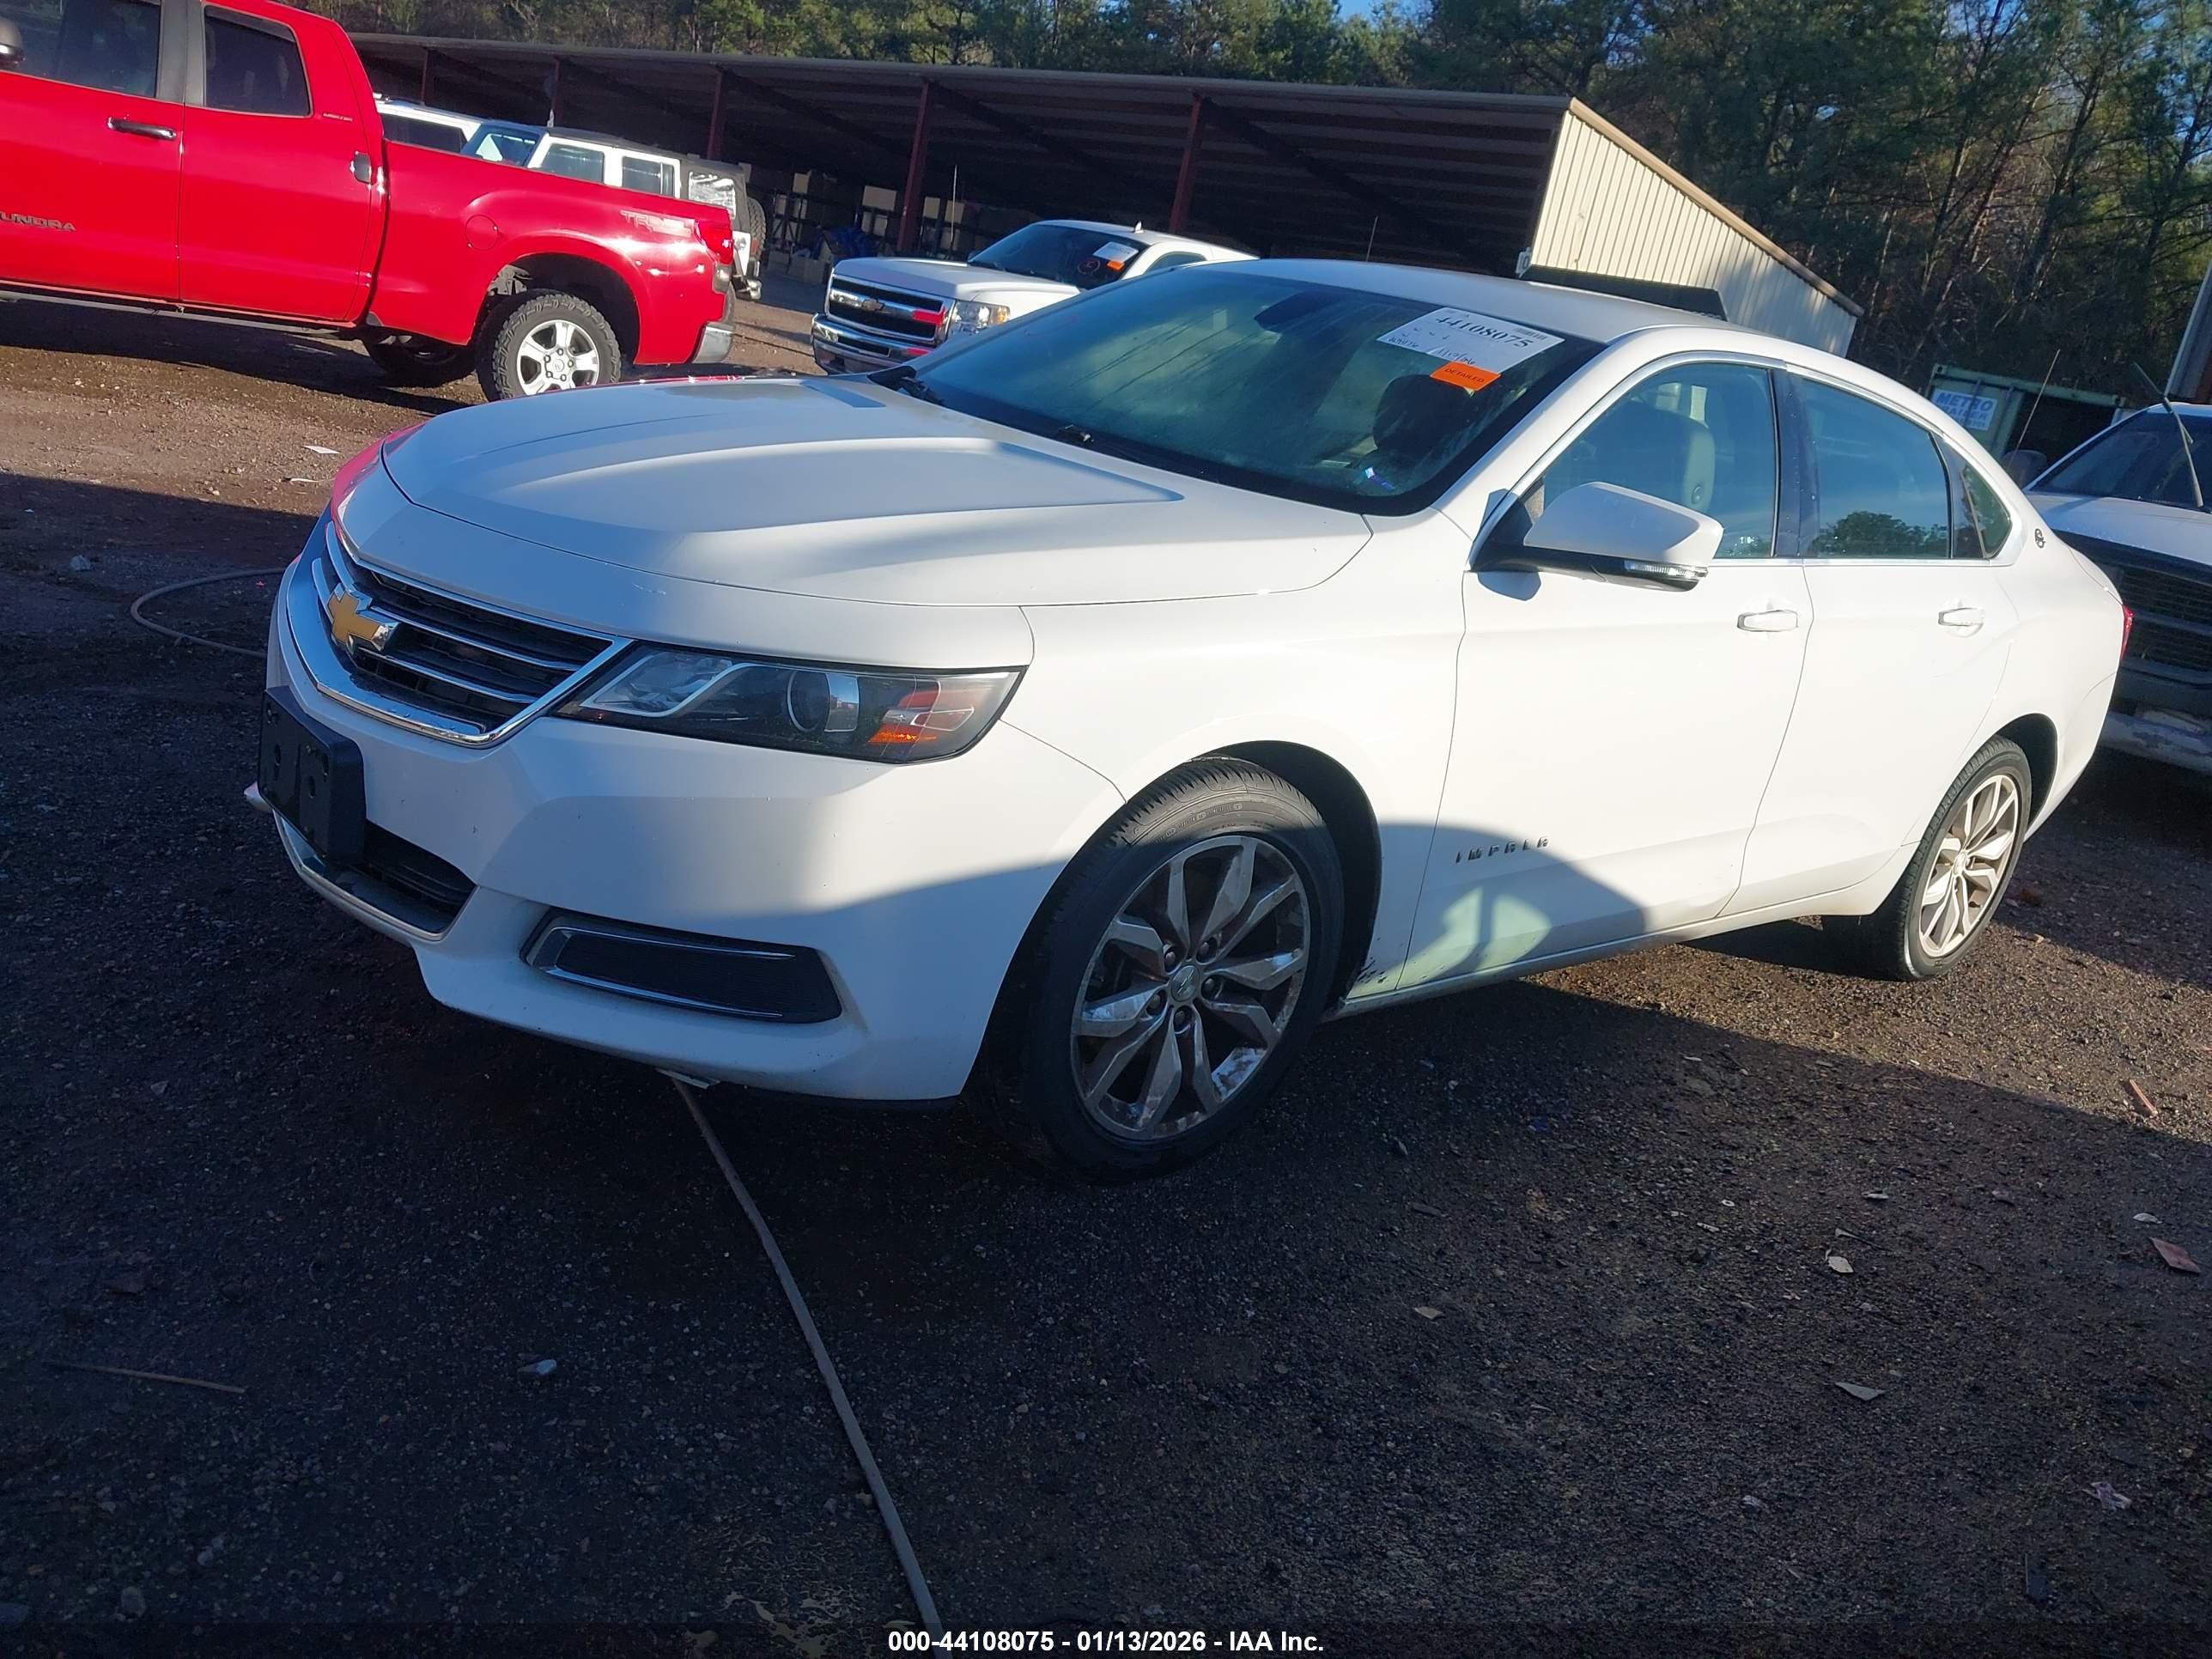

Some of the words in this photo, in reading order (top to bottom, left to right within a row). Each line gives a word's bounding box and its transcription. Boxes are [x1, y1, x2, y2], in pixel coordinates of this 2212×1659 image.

[0, 211, 76, 232] UNDRA
[1436, 316, 1534, 348] 44108075
[1444, 368, 1485, 383] DETAILED
